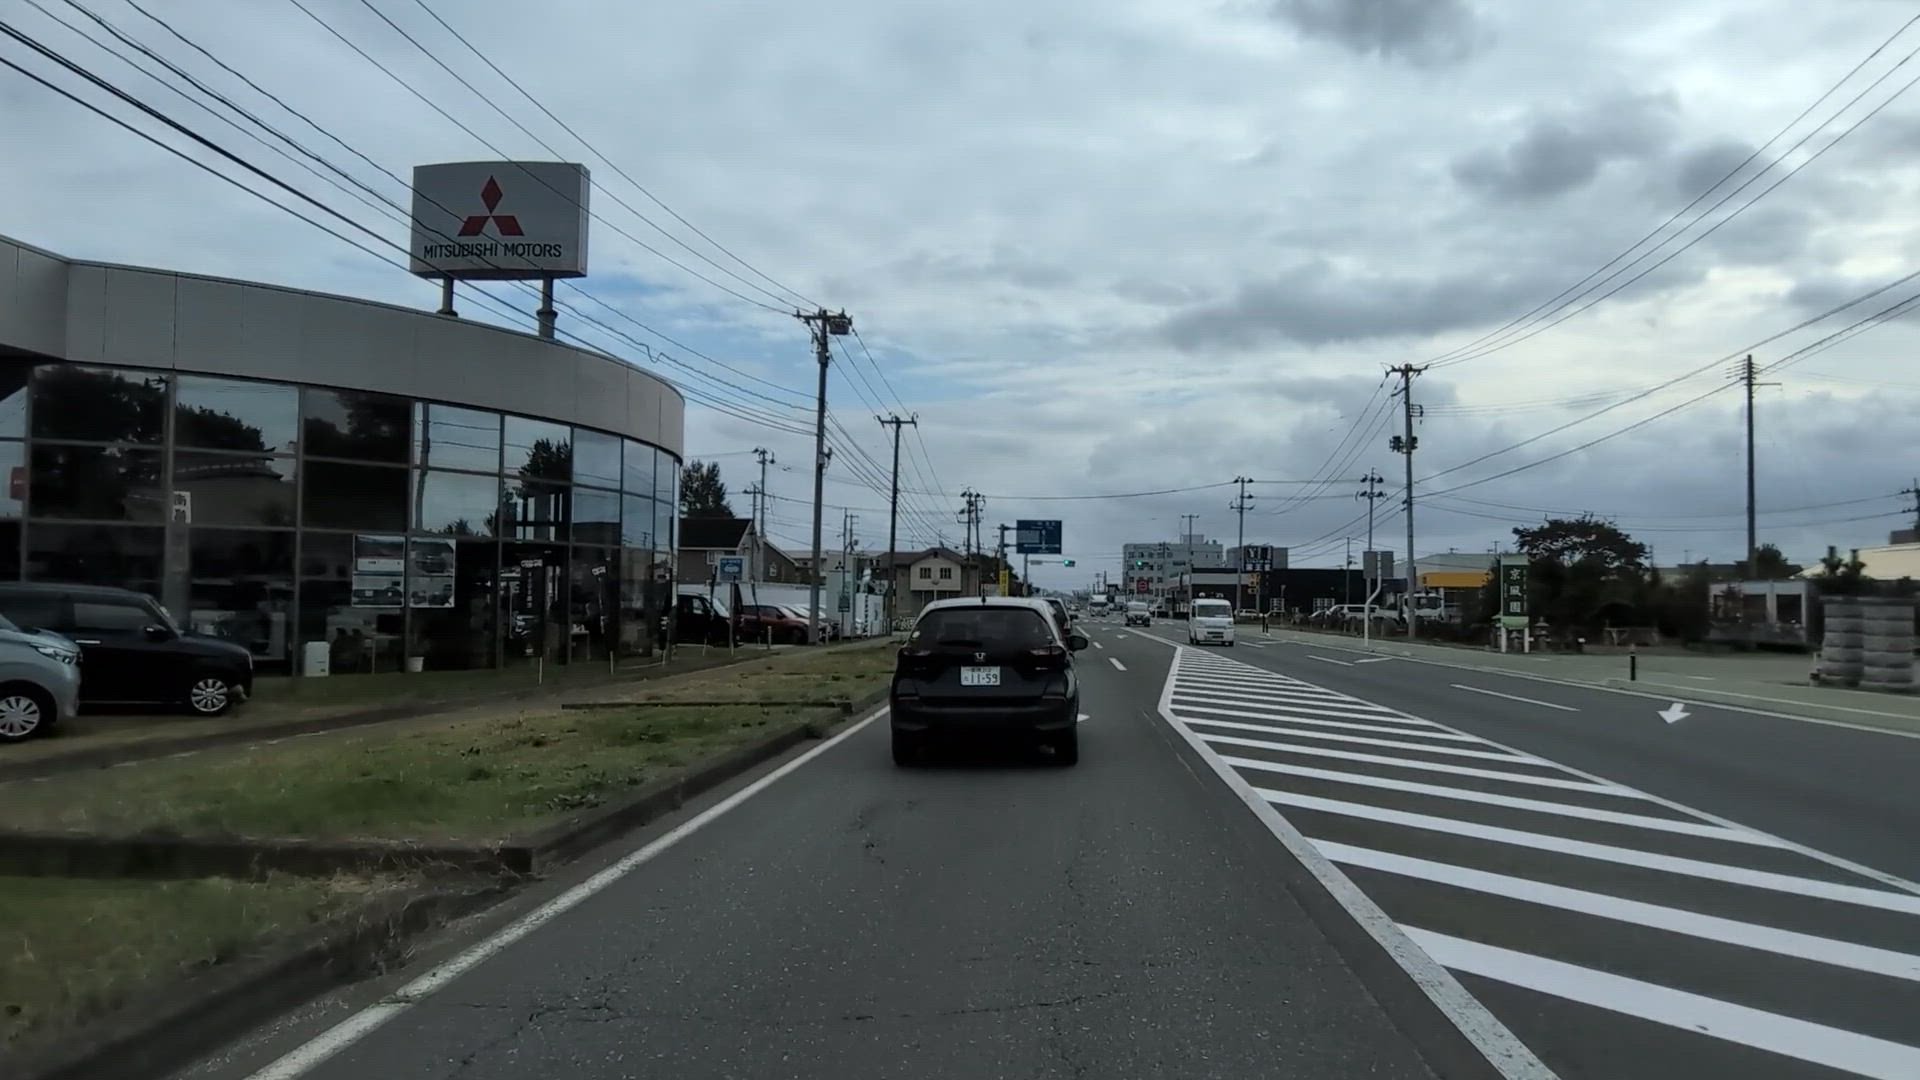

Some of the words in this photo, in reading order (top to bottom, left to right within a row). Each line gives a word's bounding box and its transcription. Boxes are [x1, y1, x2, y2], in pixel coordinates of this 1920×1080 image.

[424, 242, 498, 259] MITSUBISHI
[503, 242, 562, 258] MOTORS
[971, 673, 998, 684] 11-59
